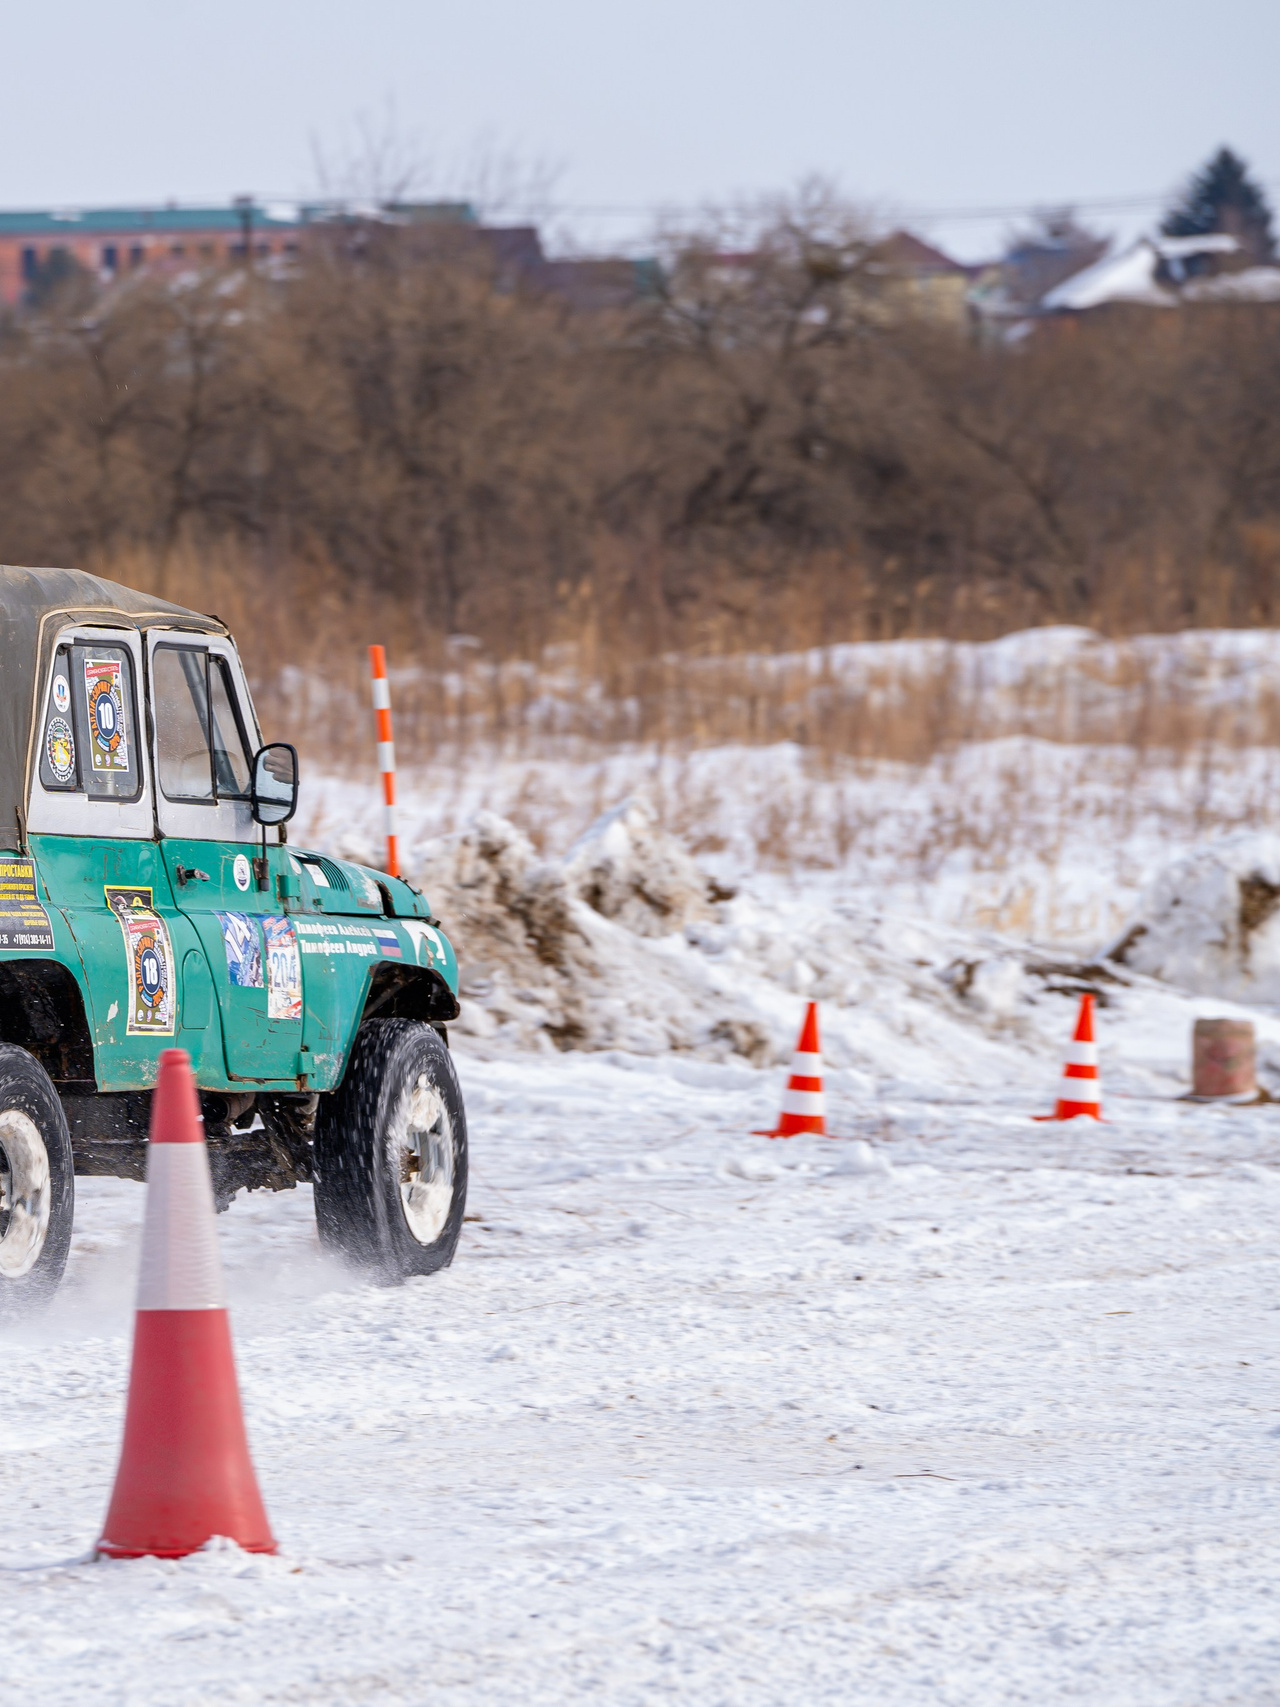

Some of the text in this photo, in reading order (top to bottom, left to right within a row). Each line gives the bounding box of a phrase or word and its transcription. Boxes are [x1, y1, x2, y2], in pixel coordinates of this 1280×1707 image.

[98, 702, 114, 730] 10
[0, 863, 34, 878] ПРОСТАВКИ
[300, 939, 378, 957] Тимофеев Андрей
[143, 958, 159, 985] 18
[272, 952, 297, 989] 204
